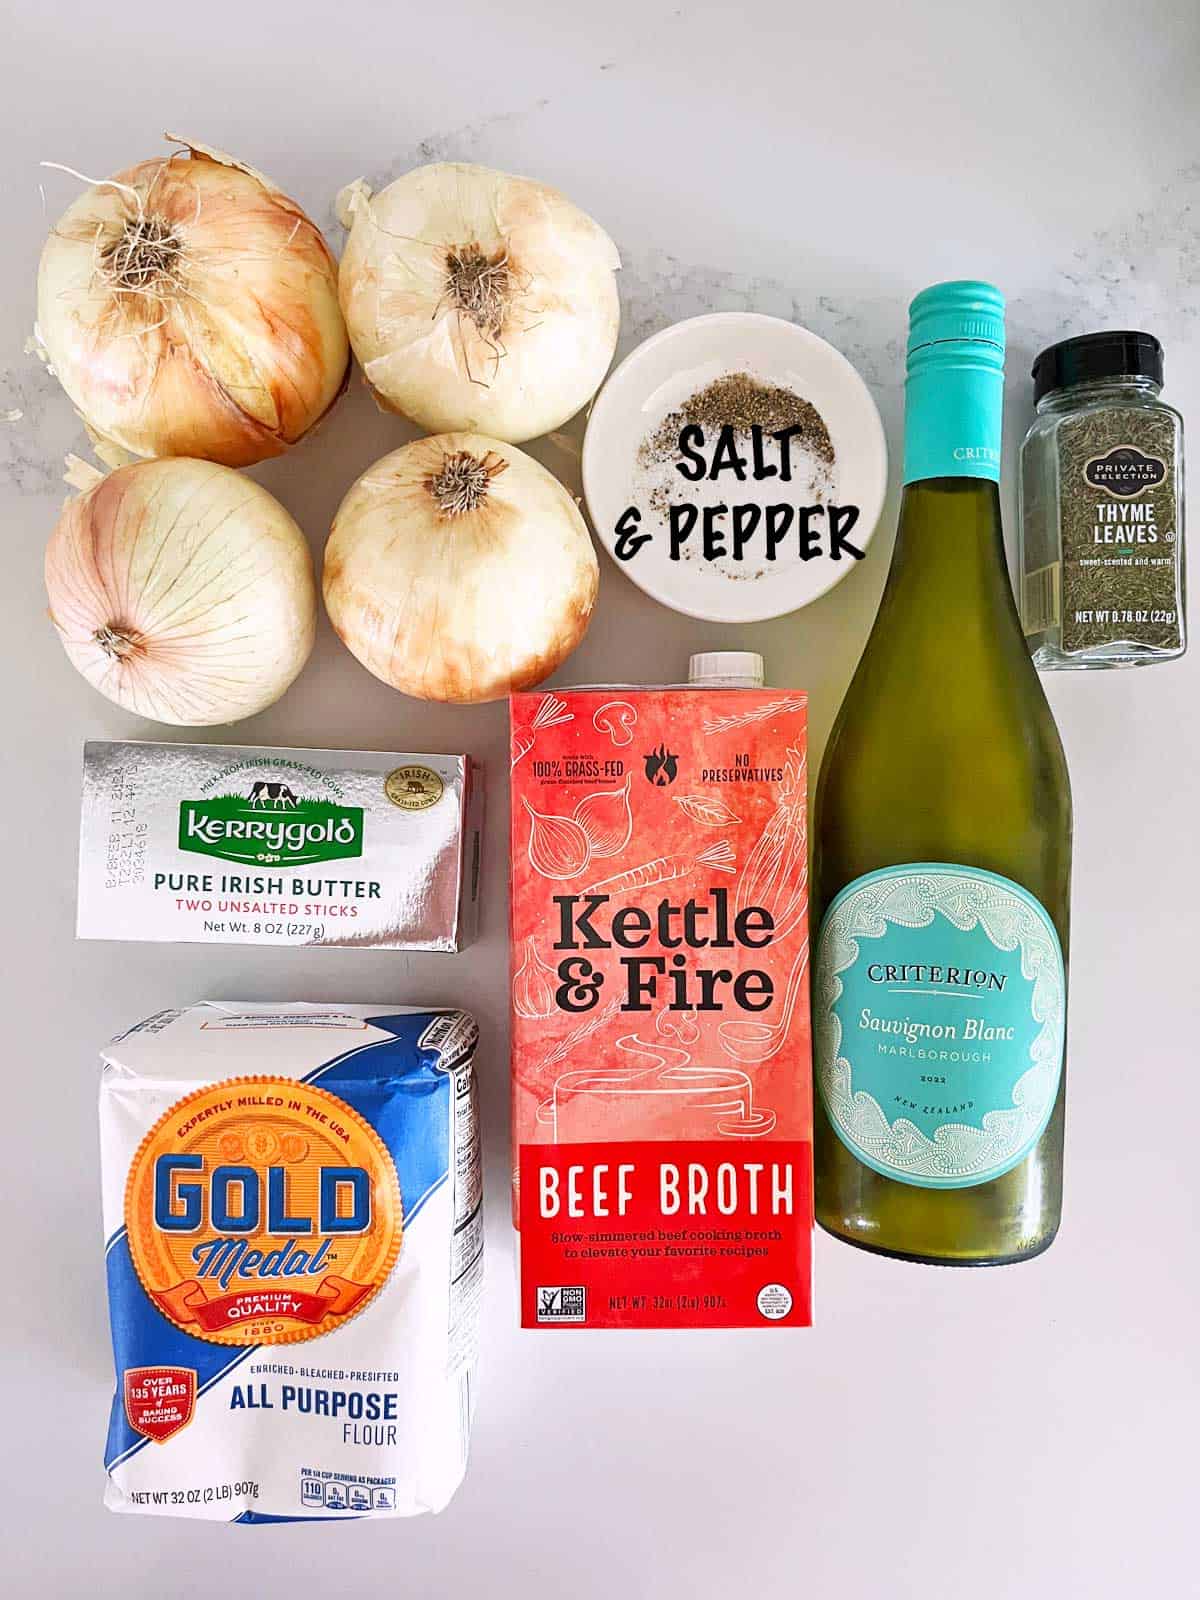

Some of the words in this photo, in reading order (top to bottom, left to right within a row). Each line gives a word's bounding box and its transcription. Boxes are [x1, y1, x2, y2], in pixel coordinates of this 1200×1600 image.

[1096, 464, 1153, 472] PRIVATE
[1096, 503, 1155, 522] THYME
[1094, 524, 1158, 543] LEAVES
[1080, 558, 1132, 566] sweet-scented
[1135, 558, 1148, 566] and
[1150, 558, 1171, 566] warm
[1076, 610, 1093, 623] NET
[1095, 610, 1109, 622] WT
[1112, 610, 1132, 622] 0.78
[1135, 610, 1147, 622] OZ
[1151, 610, 1176, 624] (22g)
[735, 753, 750, 766] NO
[400, 769, 430, 780] IRISH
[533, 761, 561, 777] 100%
[565, 760, 623, 777] GRASS-FED
[702, 767, 783, 782] PRESERVATIVES
[200, 775, 220, 793] MILK
[220, 763, 244, 778] FROM
[245, 758, 271, 769] IRISH
[272, 758, 322, 779] GRASS-FED
[322, 776, 345, 798] COWS
[154, 873, 213, 892] PURE
[221, 875, 283, 895] IRISH
[291, 878, 382, 898] BUTTER
[175, 899, 212, 912] TWO
[218, 901, 298, 915] UNSALTED
[304, 904, 358, 917] STICKS
[204, 921, 224, 932] Net
[228, 922, 249, 933] Wt.
[253, 923, 261, 933] 8
[264, 924, 282, 934] OZ
[552, 888, 775, 950] Kettle
[555, 956, 604, 1013] &
[620, 954, 774, 1012] Fire
[868, 964, 1008, 992] CRITERION
[859, 1008, 956, 1044] Sauvignon
[963, 1018, 1015, 1041] Blanc
[878, 1043, 992, 1063] MARLBOROUGH
[920, 1075, 946, 1083] 2022
[894, 1096, 917, 1109] NEW
[923, 1101, 974, 1114] ZEALAND
[177, 1100, 233, 1138] EXPERTLY
[238, 1096, 284, 1106] MILLED
[288, 1100, 301, 1111] IN
[305, 1105, 328, 1124] THE
[329, 1121, 350, 1144] USA
[153, 1153, 371, 1234] GOLD
[539, 1164, 635, 1219] BEEF
[659, 1162, 793, 1216] BROTH
[551, 1230, 654, 1244] Slow-simmered
[659, 1229, 688, 1241] beef
[690, 1229, 743, 1243] cooking
[744, 1229, 782, 1241] broth
[564, 1249, 578, 1258] to
[581, 1247, 628, 1258] elevate
[631, 1247, 663, 1258] your
[664, 1245, 717, 1257] favorite
[720, 1246, 769, 1258] recipes
[191, 1237, 331, 1290] Medal
[236, 1294, 292, 1305] PREMIUM
[609, 1296, 627, 1309] NET
[227, 1302, 302, 1318] QUALITY
[244, 1324, 284, 1336] 1880
[143, 1377, 173, 1386] OVER
[250, 1364, 294, 1375] ENRICHED
[300, 1367, 344, 1380] BLEACHED
[350, 1372, 399, 1382] PRESIFTED
[131, 1388, 149, 1399] 135
[151, 1383, 187, 1399] YEARS
[229, 1384, 274, 1410] ALL
[282, 1385, 398, 1420] PURPOSE
[138, 1413, 182, 1424] SUCCESS
[143, 1407, 178, 1417] BAKING
[343, 1423, 397, 1446] FLOUR
[301, 1467, 312, 1476] PER
[321, 1471, 333, 1479] CUP
[366, 1476, 396, 1485] PACKAGED
[131, 1491, 151, 1504] NET
[152, 1491, 169, 1504] WT
[171, 1491, 185, 1504] 32
[187, 1490, 201, 1503] OZ
[203, 1487, 214, 1504] (2
[216, 1485, 232, 1500] LB)
[234, 1481, 259, 1498] 907g
[304, 1482, 321, 1494] 110
